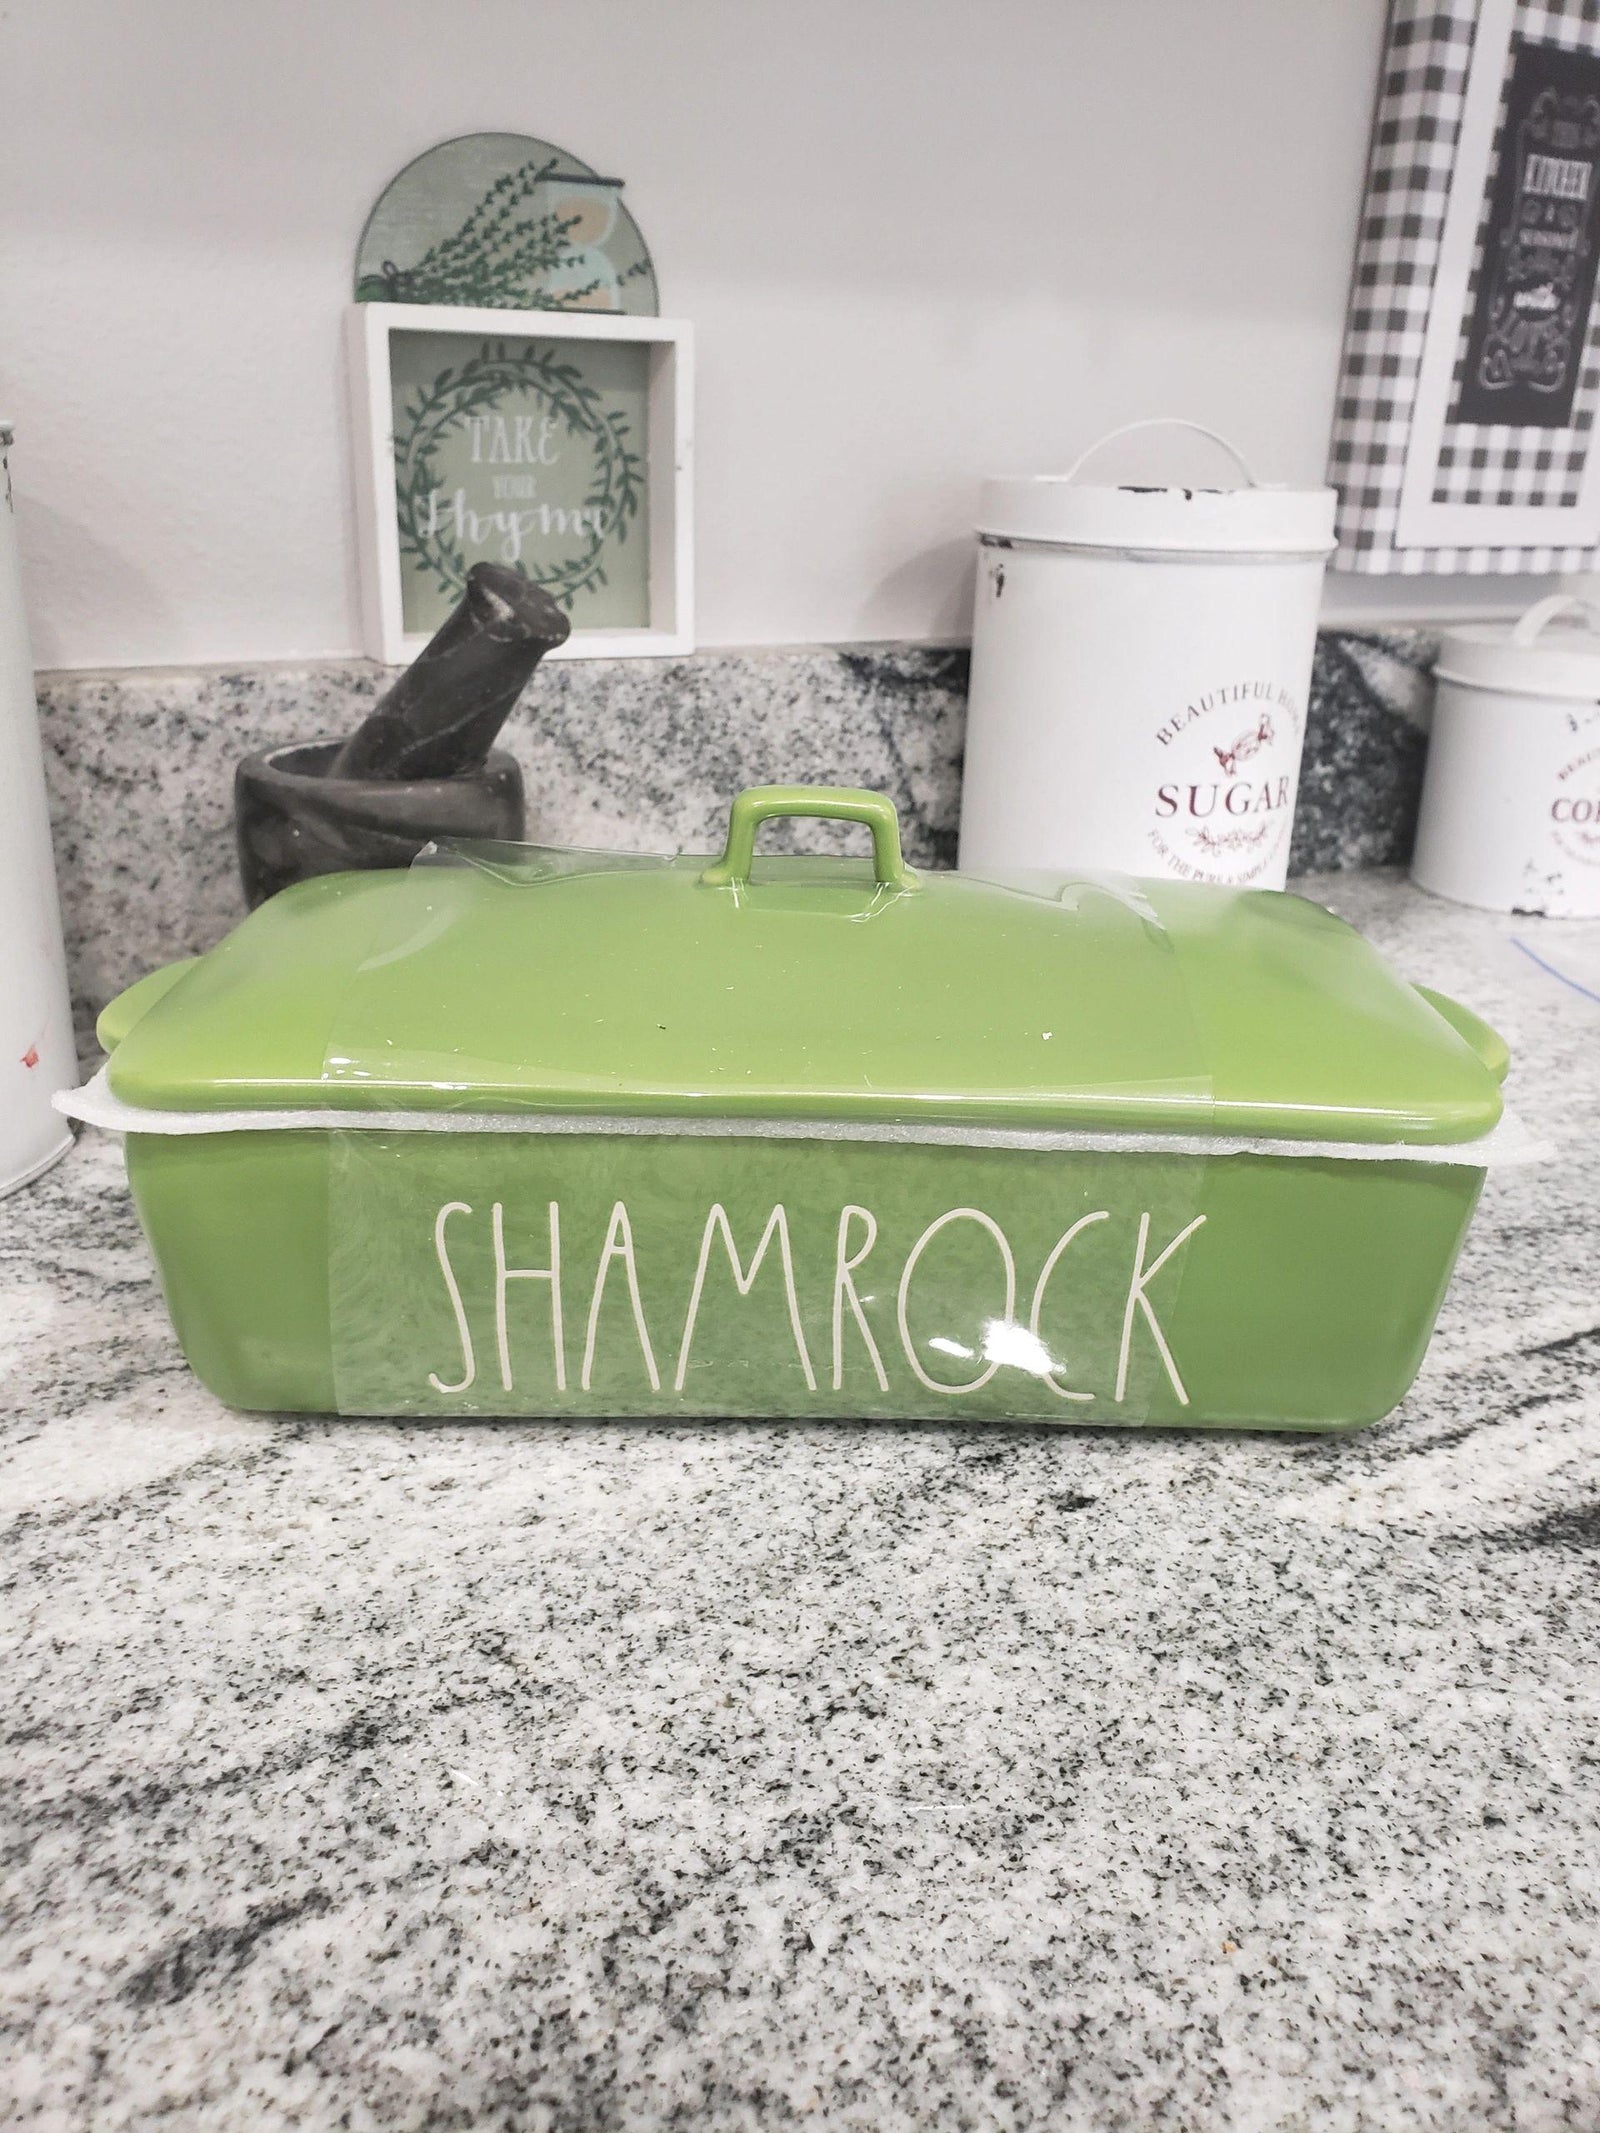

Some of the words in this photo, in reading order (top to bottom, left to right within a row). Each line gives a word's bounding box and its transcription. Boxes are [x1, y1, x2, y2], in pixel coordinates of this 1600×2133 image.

[465, 415, 560, 466] TAKE
[1155, 680, 1274, 746] BEAUTIFUL
[1155, 775, 1291, 819] SUGAR
[428, 1201, 1207, 1406] SHAMROCK
